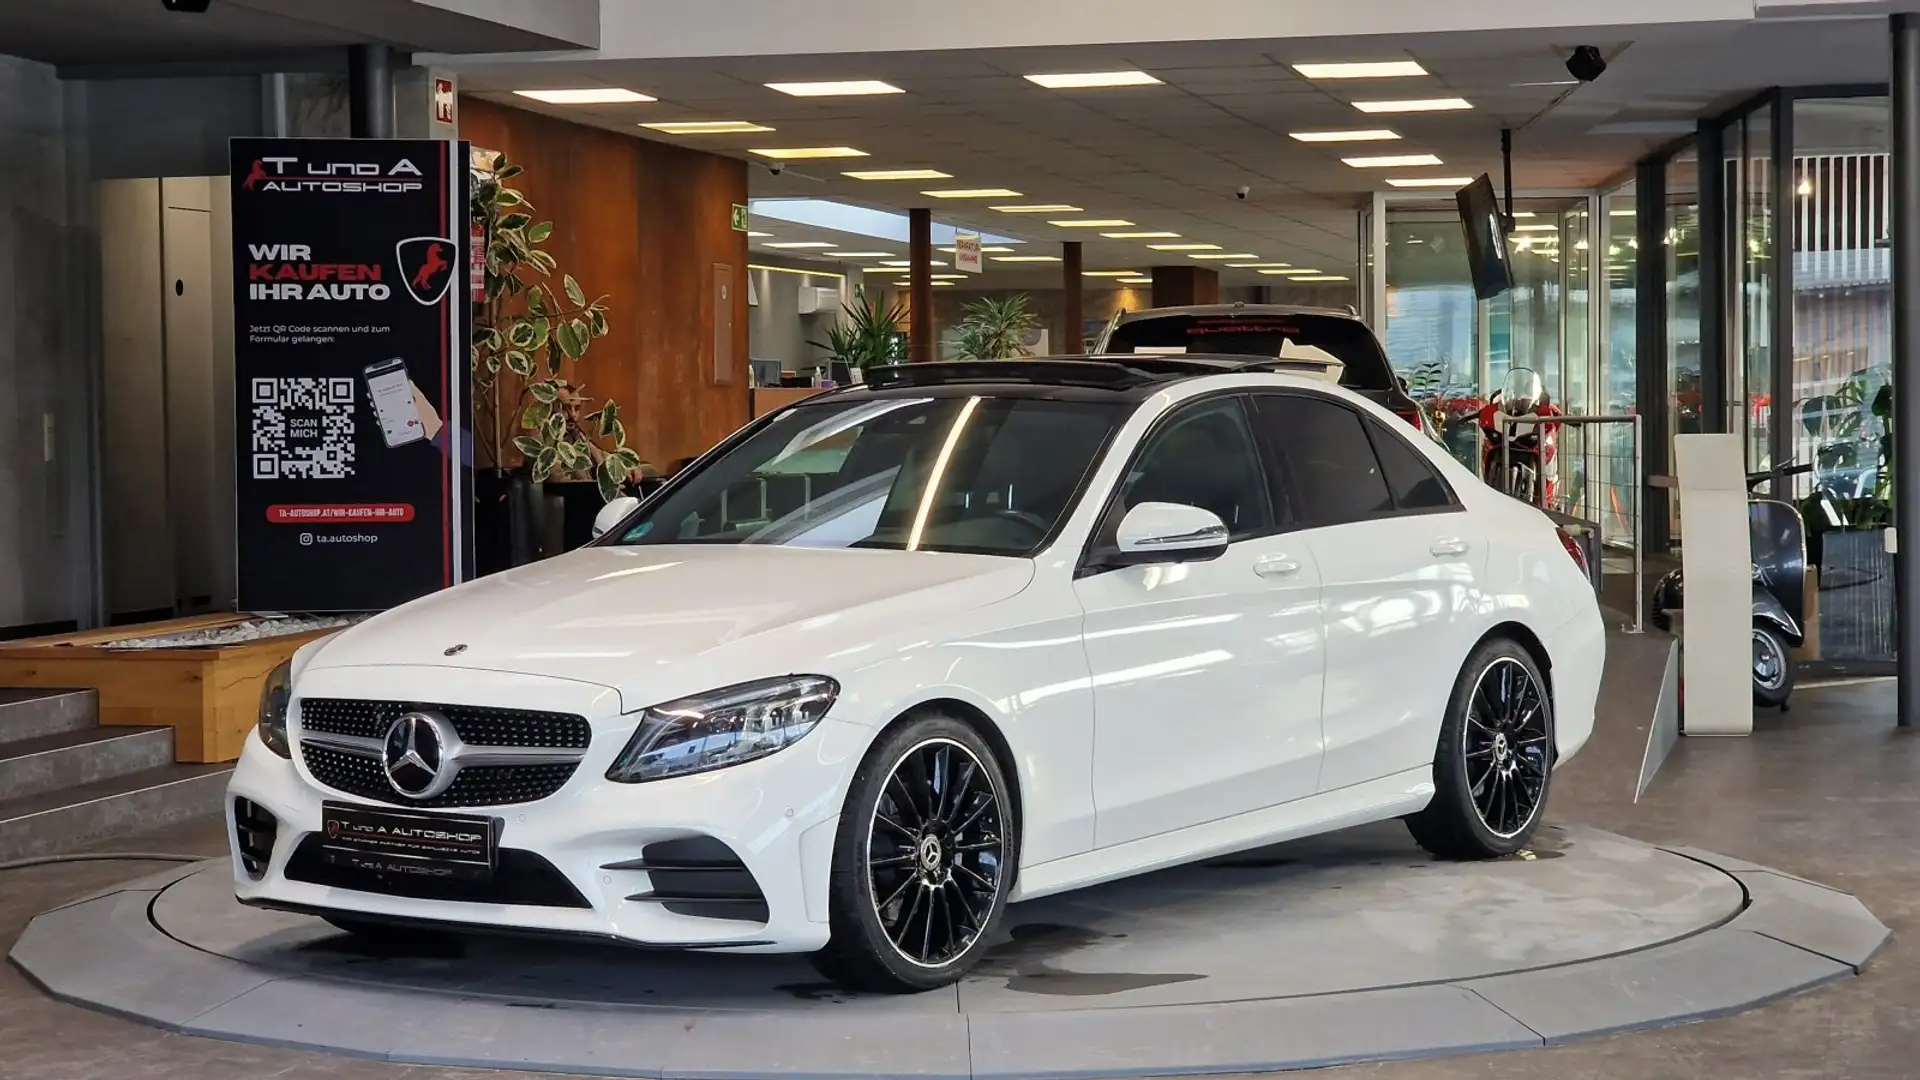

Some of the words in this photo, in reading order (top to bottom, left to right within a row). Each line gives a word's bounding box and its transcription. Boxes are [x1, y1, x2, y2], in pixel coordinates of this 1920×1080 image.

[262, 157, 298, 174] T
[387, 158, 423, 176] A
[262, 181, 423, 193] AUTOSHOP
[248, 244, 311, 261] WIR
[249, 264, 382, 281] KAUFEN
[249, 284, 303, 300] IHR
[306, 284, 391, 300] AUTO
[249, 325, 271, 333] Jetzt
[272, 325, 287, 334] QR
[288, 325, 311, 333] Code
[351, 325, 370, 333] und
[1186, 325, 1300, 335] quattro
[249, 335, 290, 343] Formular
[290, 418, 318, 428] SCAN
[290, 429, 318, 438] MICH
[316, 533, 378, 544] ta.autoshop
[340, 820, 350, 829] T
[377, 825, 388, 833] A
[391, 827, 483, 842] AUTOSHOP
